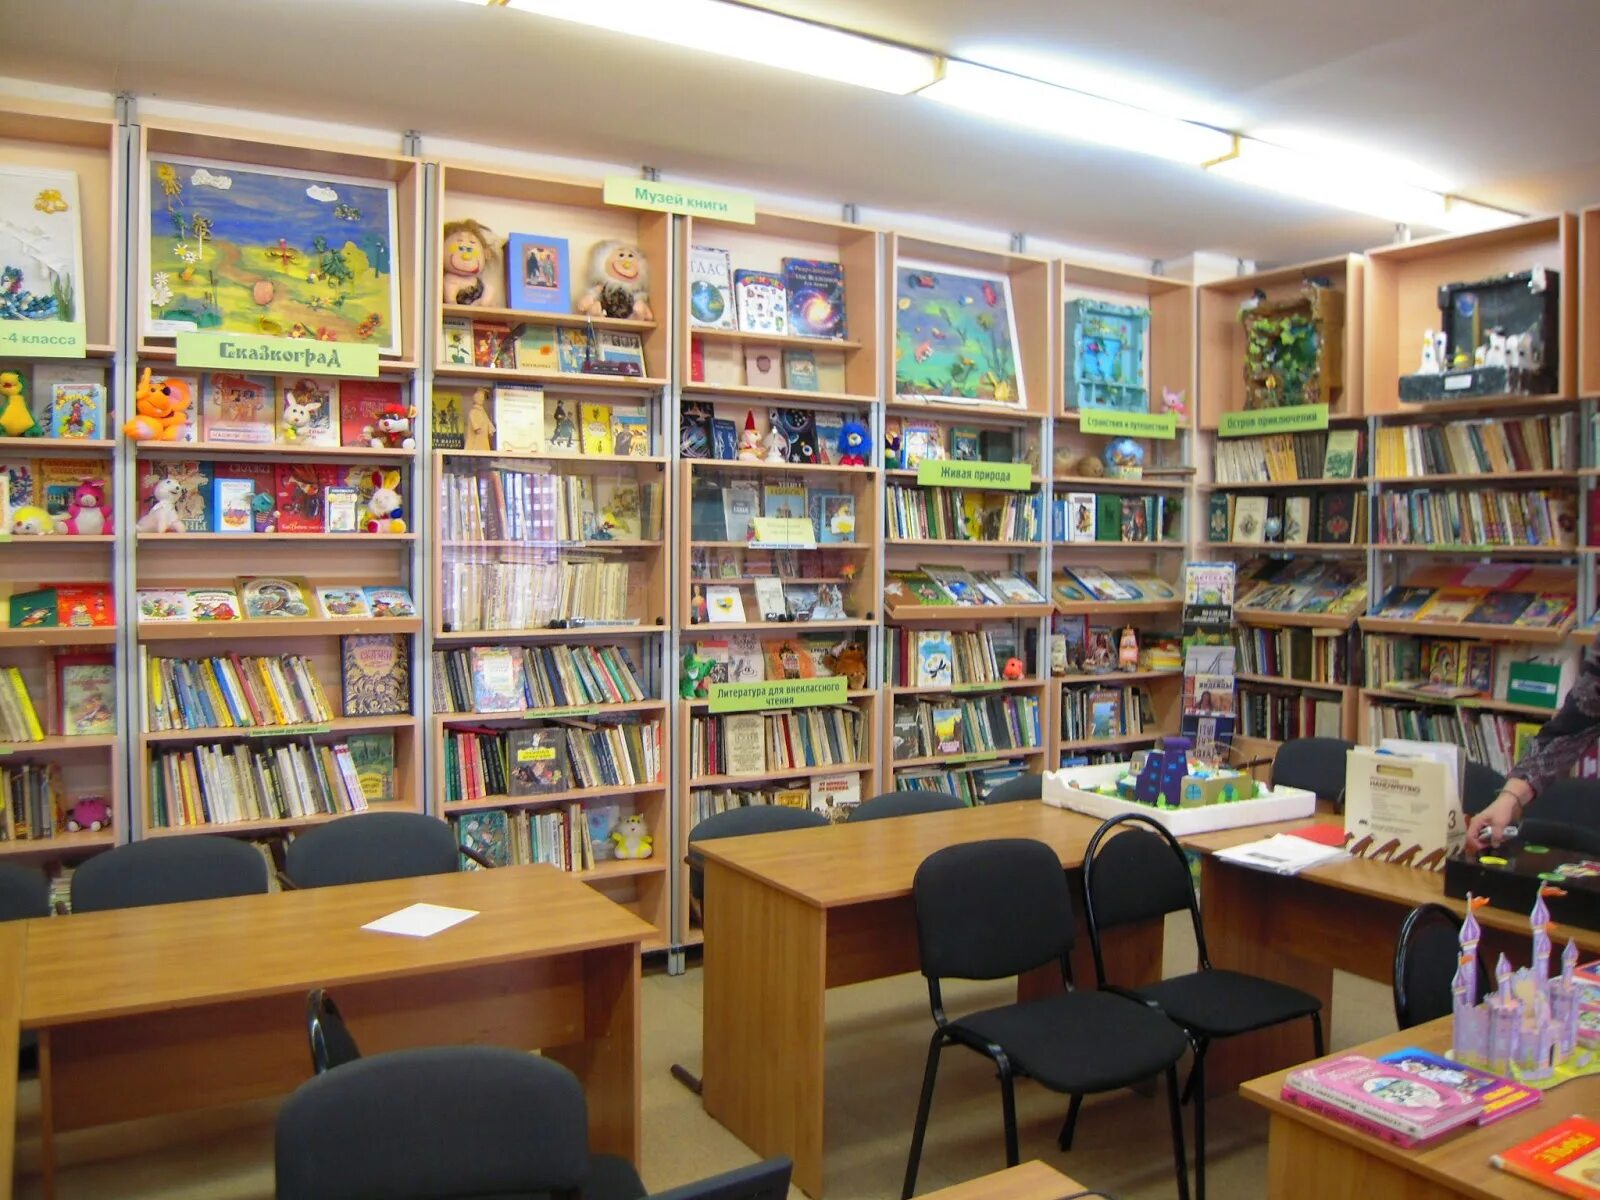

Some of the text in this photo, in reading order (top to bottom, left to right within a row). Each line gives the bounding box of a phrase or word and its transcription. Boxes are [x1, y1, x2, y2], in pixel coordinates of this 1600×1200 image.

[634, 187, 728, 212] Музей книги
[22, 335, 77, 346] класса
[1227, 412, 1317, 429] Остров приключений
[940, 466, 1011, 483] Живая природа
[717, 682, 840, 700] Литература для внеклассного
[765, 697, 795, 707] чтения
[1448, 810, 1457, 830] 3
